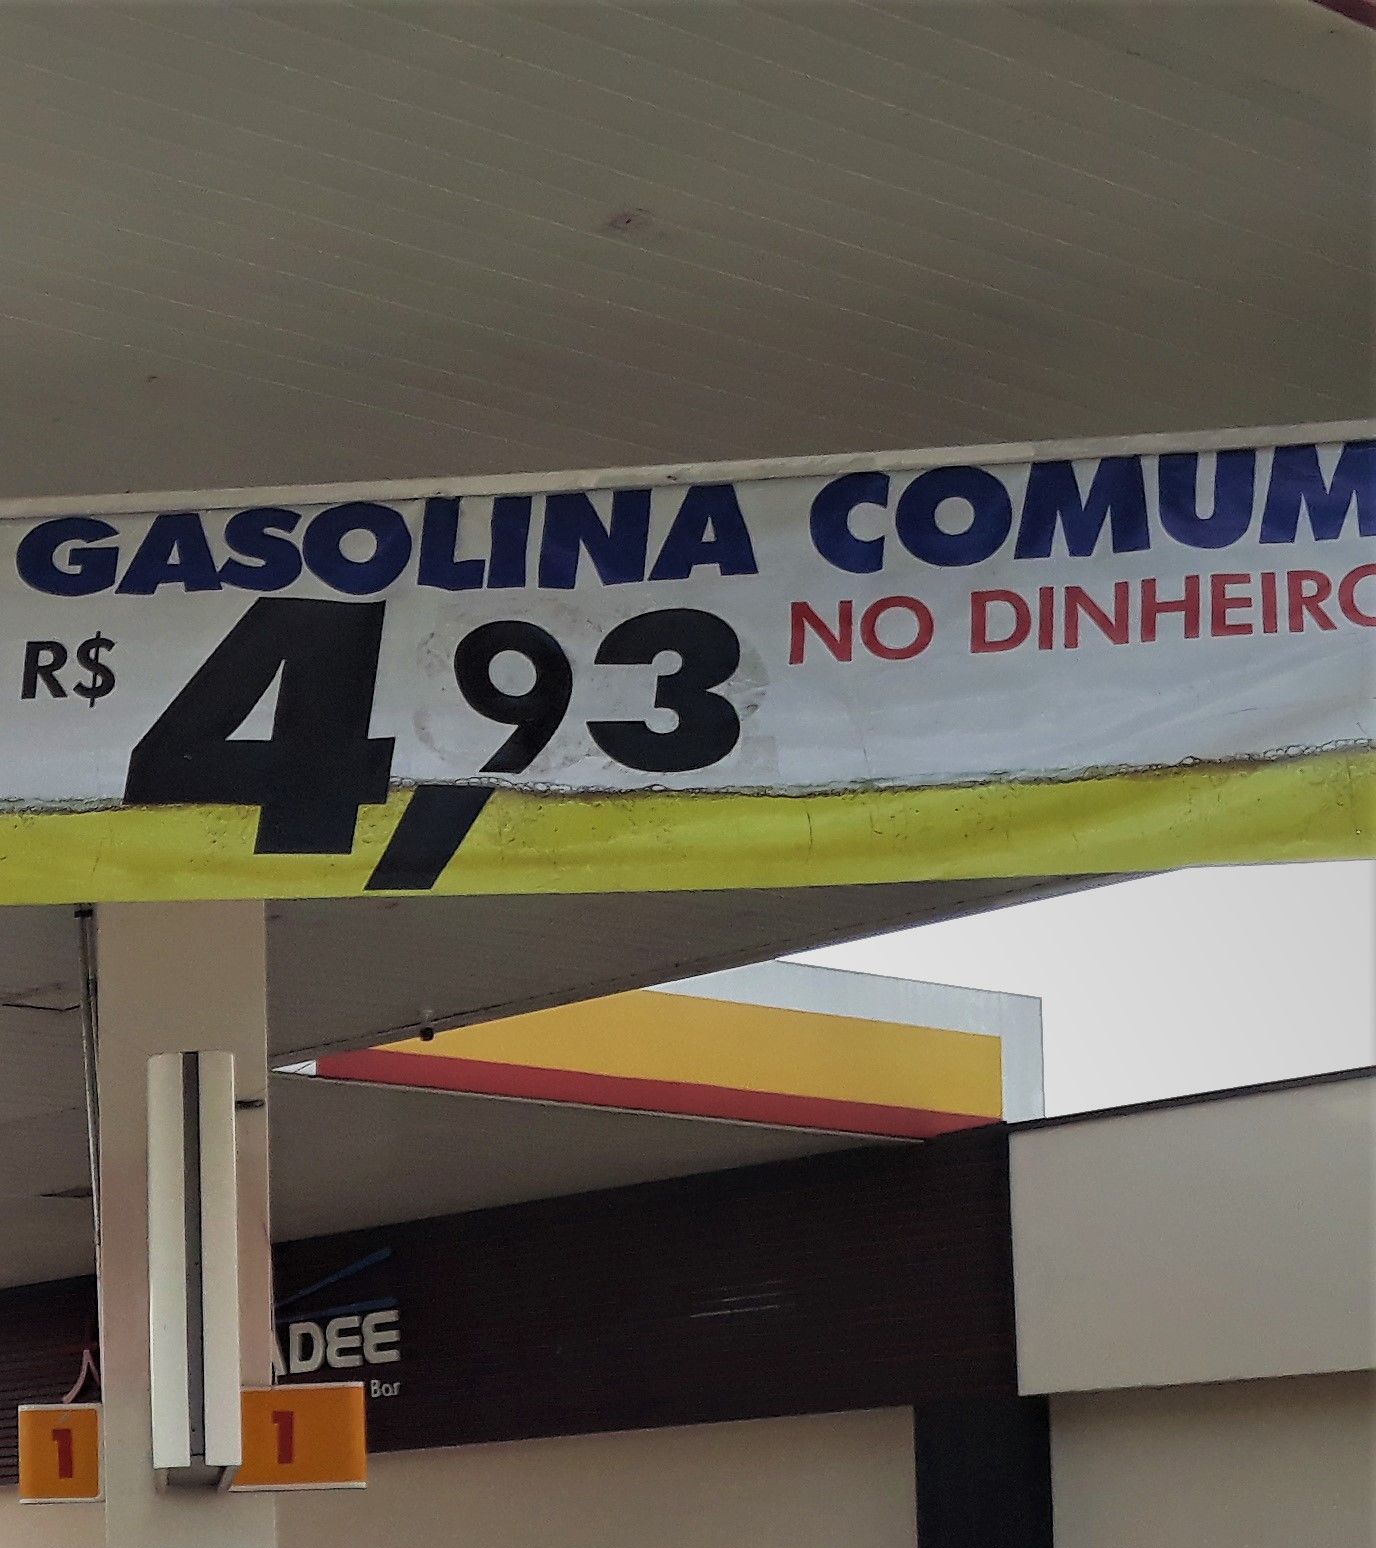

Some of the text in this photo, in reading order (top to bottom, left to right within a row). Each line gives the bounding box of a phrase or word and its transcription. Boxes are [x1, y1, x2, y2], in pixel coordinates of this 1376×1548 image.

[16, 441, 1376, 597] GASOLINA COMUM
[789, 597, 934, 667] NO
[22, 631, 115, 707] R$
[123, 597, 741, 891] 4,93
[52, 1428, 74, 1480] 1
[272, 1411, 295, 1464] 1
